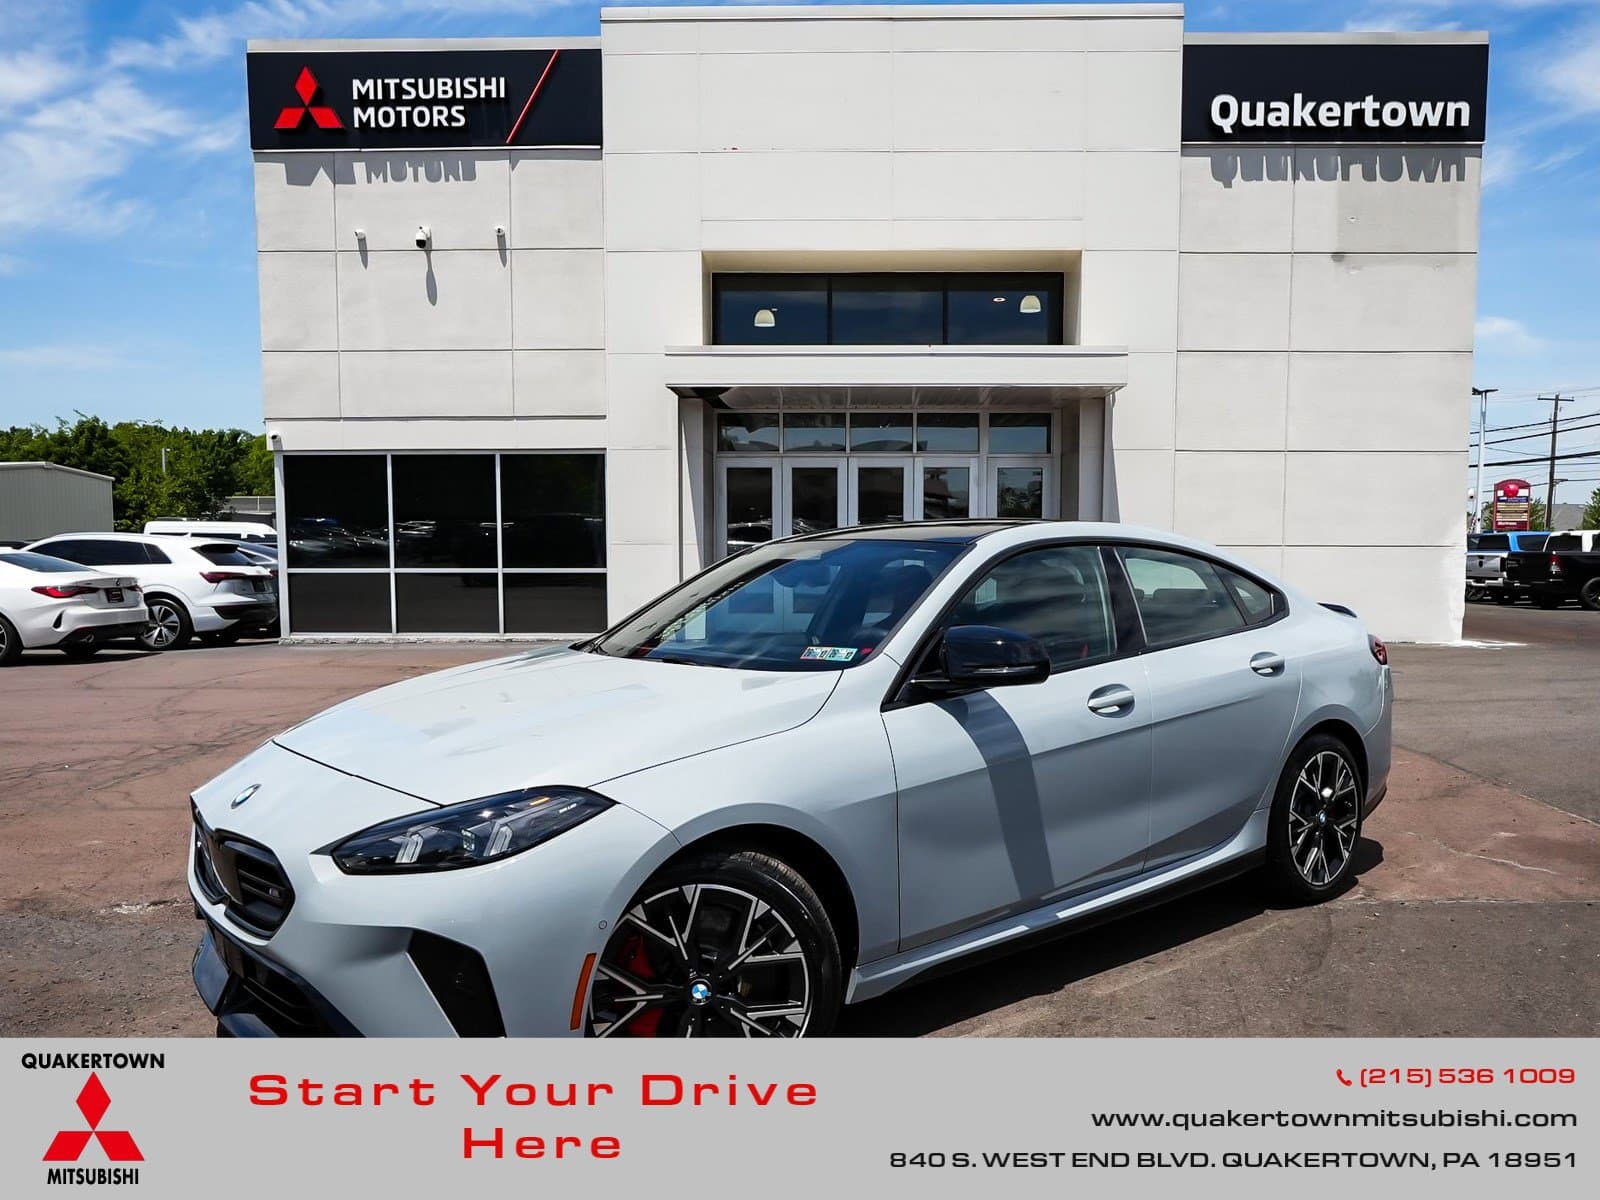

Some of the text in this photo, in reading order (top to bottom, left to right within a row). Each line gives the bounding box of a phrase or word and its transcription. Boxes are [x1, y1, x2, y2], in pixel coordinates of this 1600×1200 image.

[352, 76, 506, 101] MITSUBISHI
[352, 105, 467, 128] MOTORS
[1210, 92, 1471, 134] Quakertown
